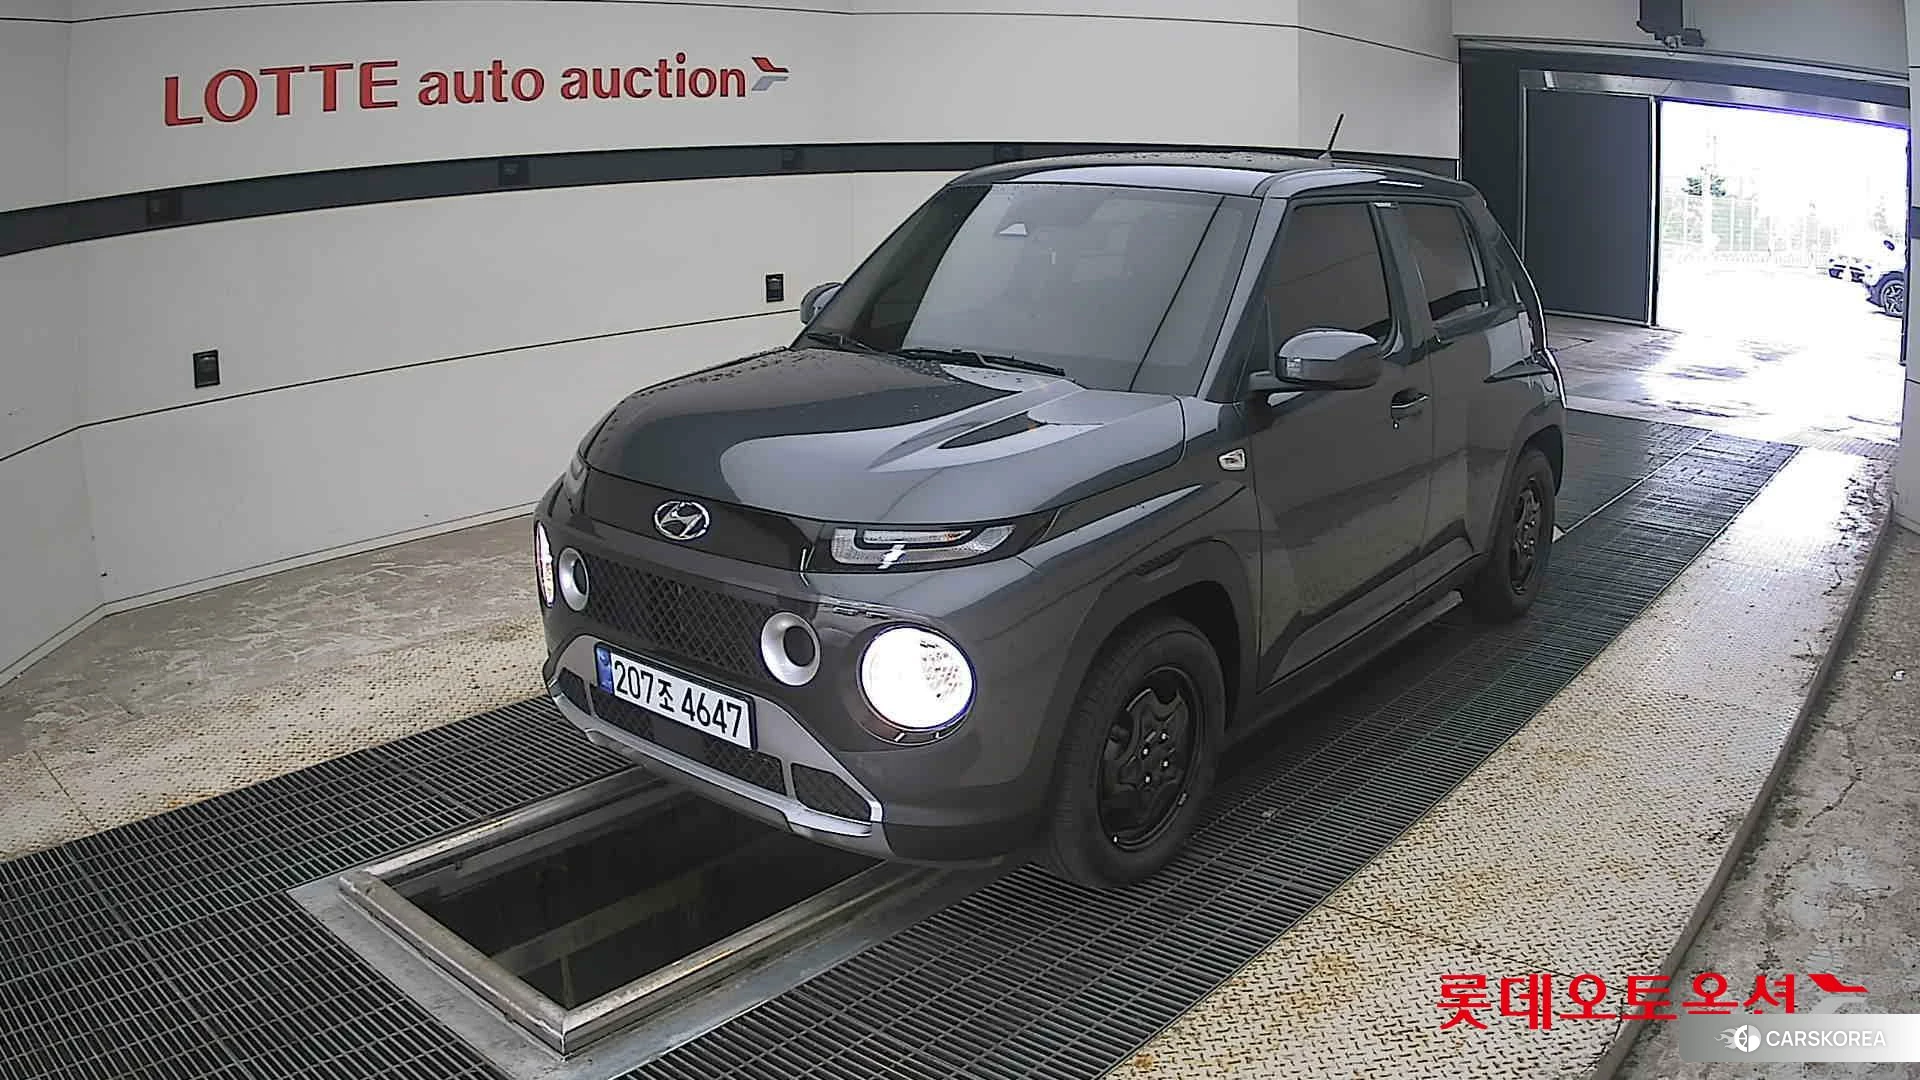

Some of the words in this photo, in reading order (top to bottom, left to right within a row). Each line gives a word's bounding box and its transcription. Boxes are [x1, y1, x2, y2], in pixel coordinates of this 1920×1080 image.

[164, 60, 399, 126] LOTTE
[417, 59, 545, 105] auto
[560, 52, 748, 100] auction
[614, 660, 675, 713] 207조
[681, 687, 742, 738] 4647
